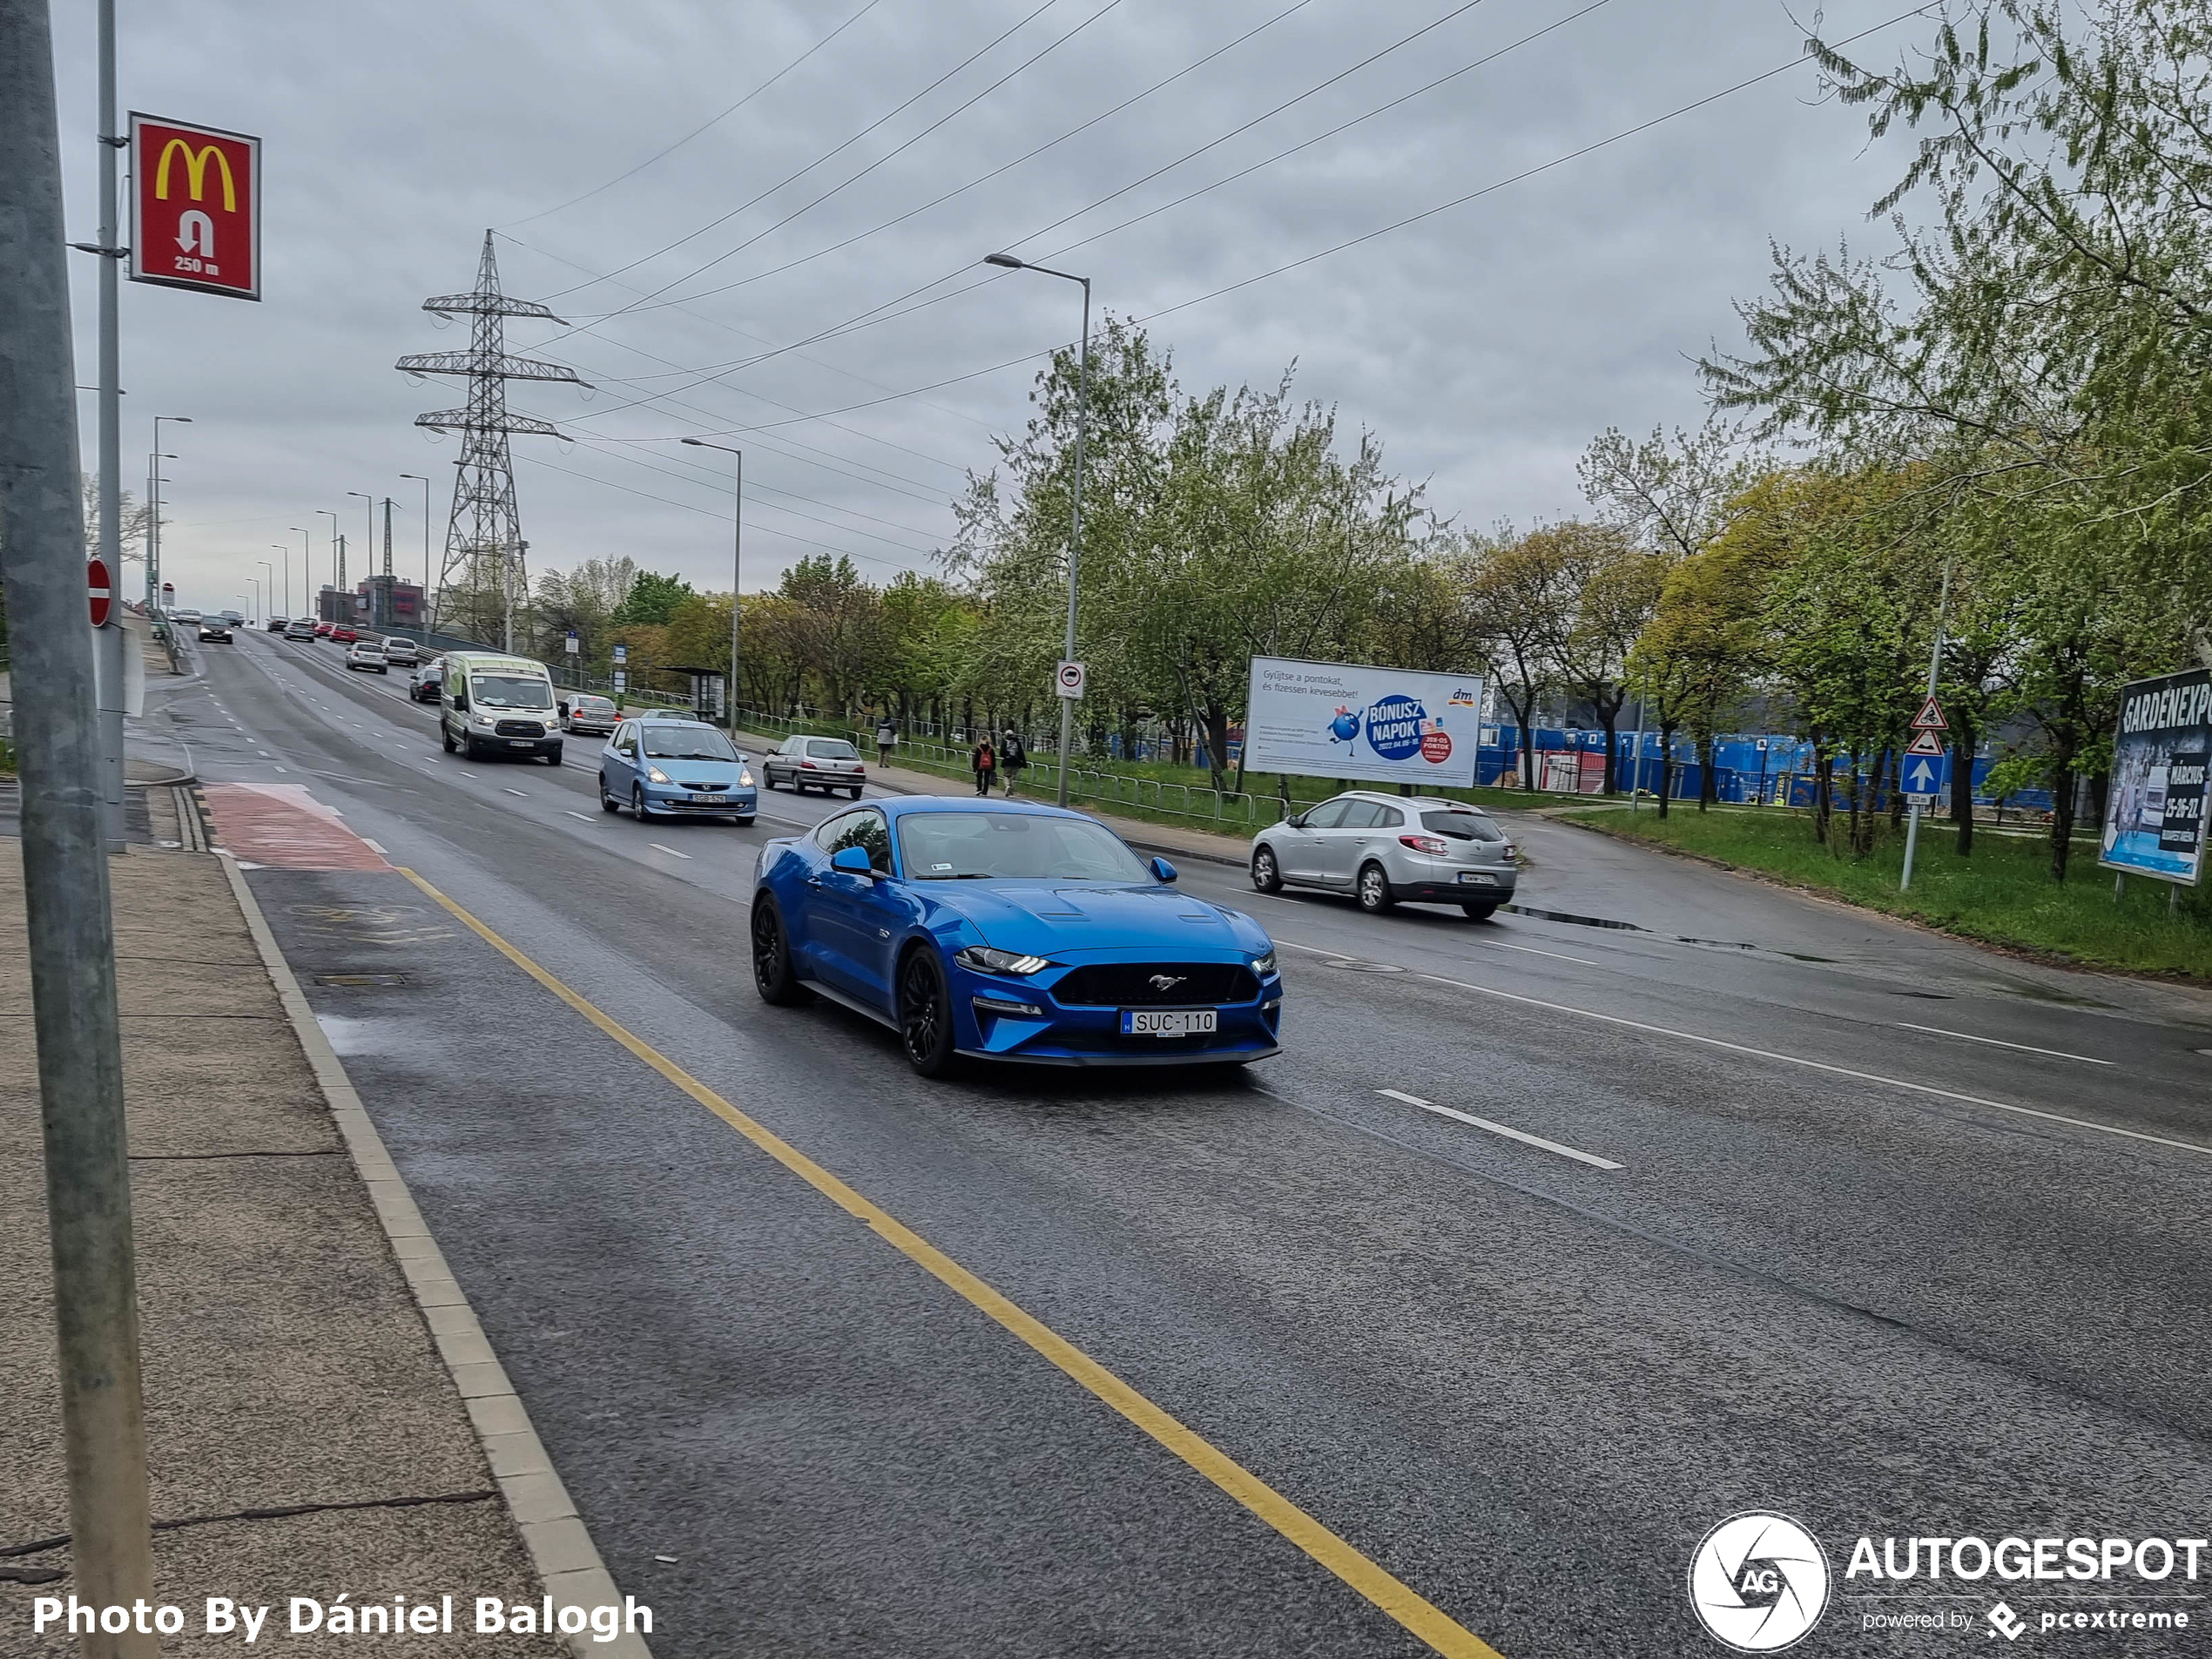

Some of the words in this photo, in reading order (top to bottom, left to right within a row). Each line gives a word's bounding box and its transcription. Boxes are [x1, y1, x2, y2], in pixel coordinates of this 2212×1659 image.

[174, 255, 202, 273] 250
[205, 263, 219, 276] m
[1263, 670, 1294, 681] Gyűjtse
[1305, 675, 1343, 686] pontokat,
[1262, 682, 1272, 691] és
[1274, 683, 1306, 694] fizessen
[1310, 686, 1359, 698] kevesebbet!
[1453, 688, 1473, 700] dm
[1370, 700, 1422, 723] BÓNUSZ
[1372, 720, 1417, 741] NAPOK
[2170, 759, 2205, 785] MÁRCIUS
[1136, 1014, 1213, 1031] SUC-110
